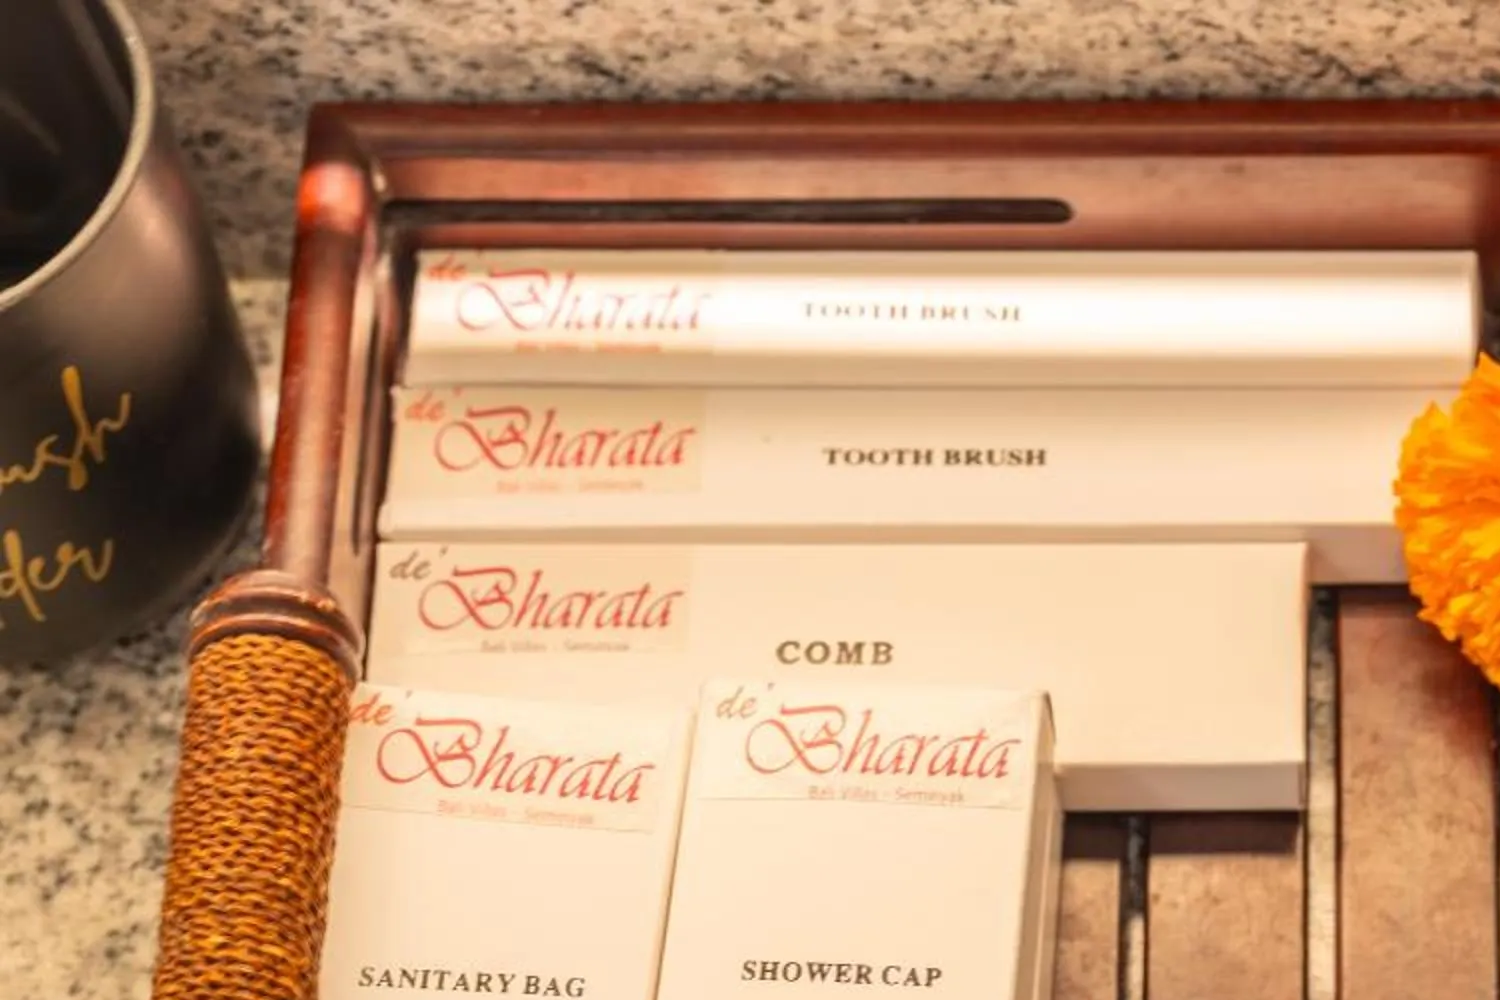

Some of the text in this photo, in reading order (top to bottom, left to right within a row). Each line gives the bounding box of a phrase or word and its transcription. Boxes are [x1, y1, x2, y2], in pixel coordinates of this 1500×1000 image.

[434, 404, 697, 472] Bharata
[822, 447, 1048, 467] TOOTH BRUSH
[0, 529, 114, 622] der
[418, 565, 686, 631] Bharata
[775, 640, 895, 666] COMB
[376, 713, 656, 803] Bharata
[744, 703, 1022, 778] Bharata
[357, 965, 587, 999] SANITARY BAG
[741, 959, 944, 989] SHOWER CAP
